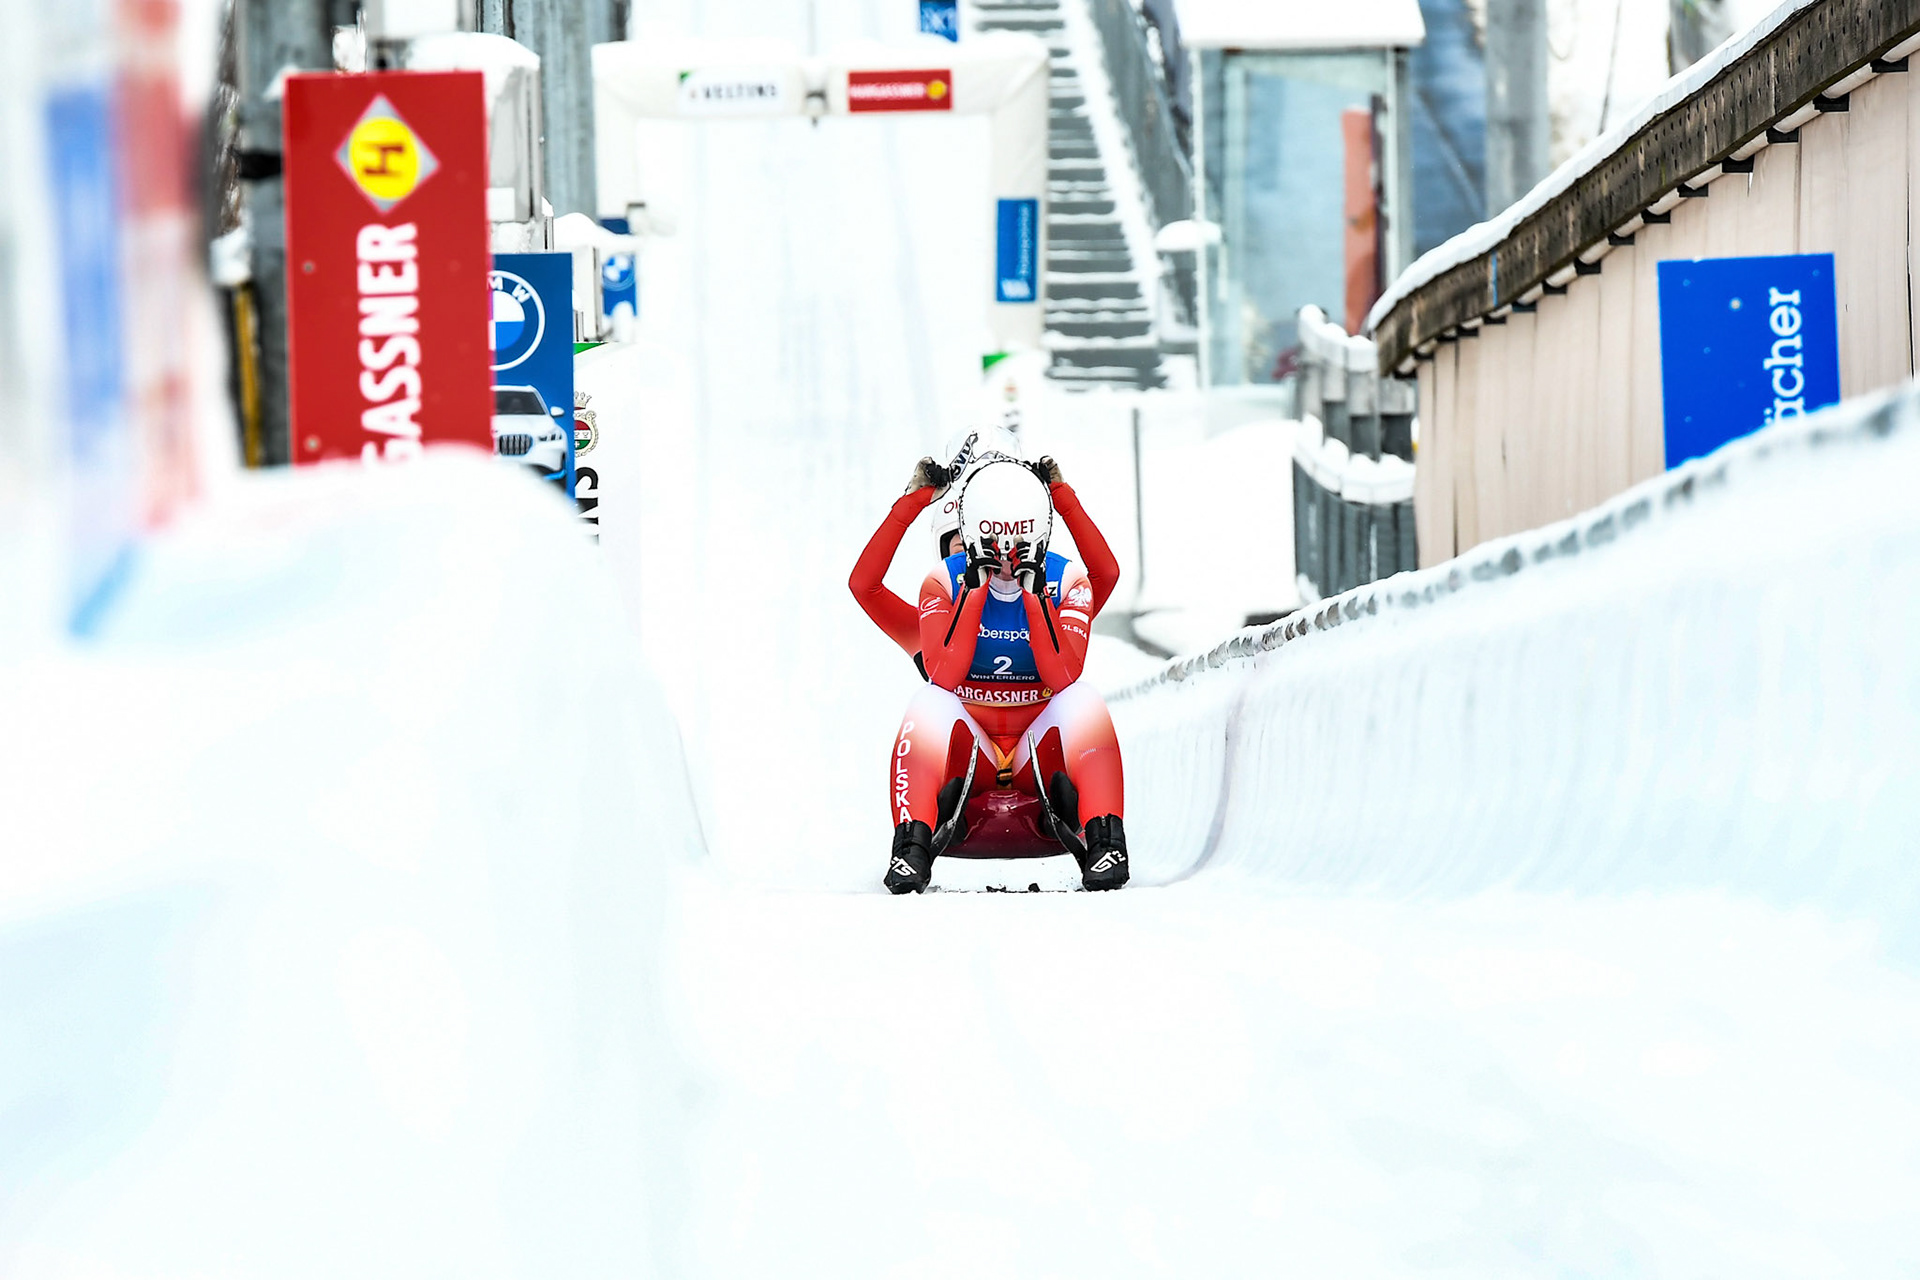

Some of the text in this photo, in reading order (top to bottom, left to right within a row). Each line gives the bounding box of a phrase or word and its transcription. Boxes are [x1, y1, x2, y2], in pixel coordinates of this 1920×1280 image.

[575, 466, 599, 546] NS
[943, 499, 958, 513] O
[979, 519, 1035, 536] ODMET
[993, 656, 1012, 674] 2
[954, 685, 1038, 702] ARGASSNER
[895, 721, 915, 824] POLSKA
